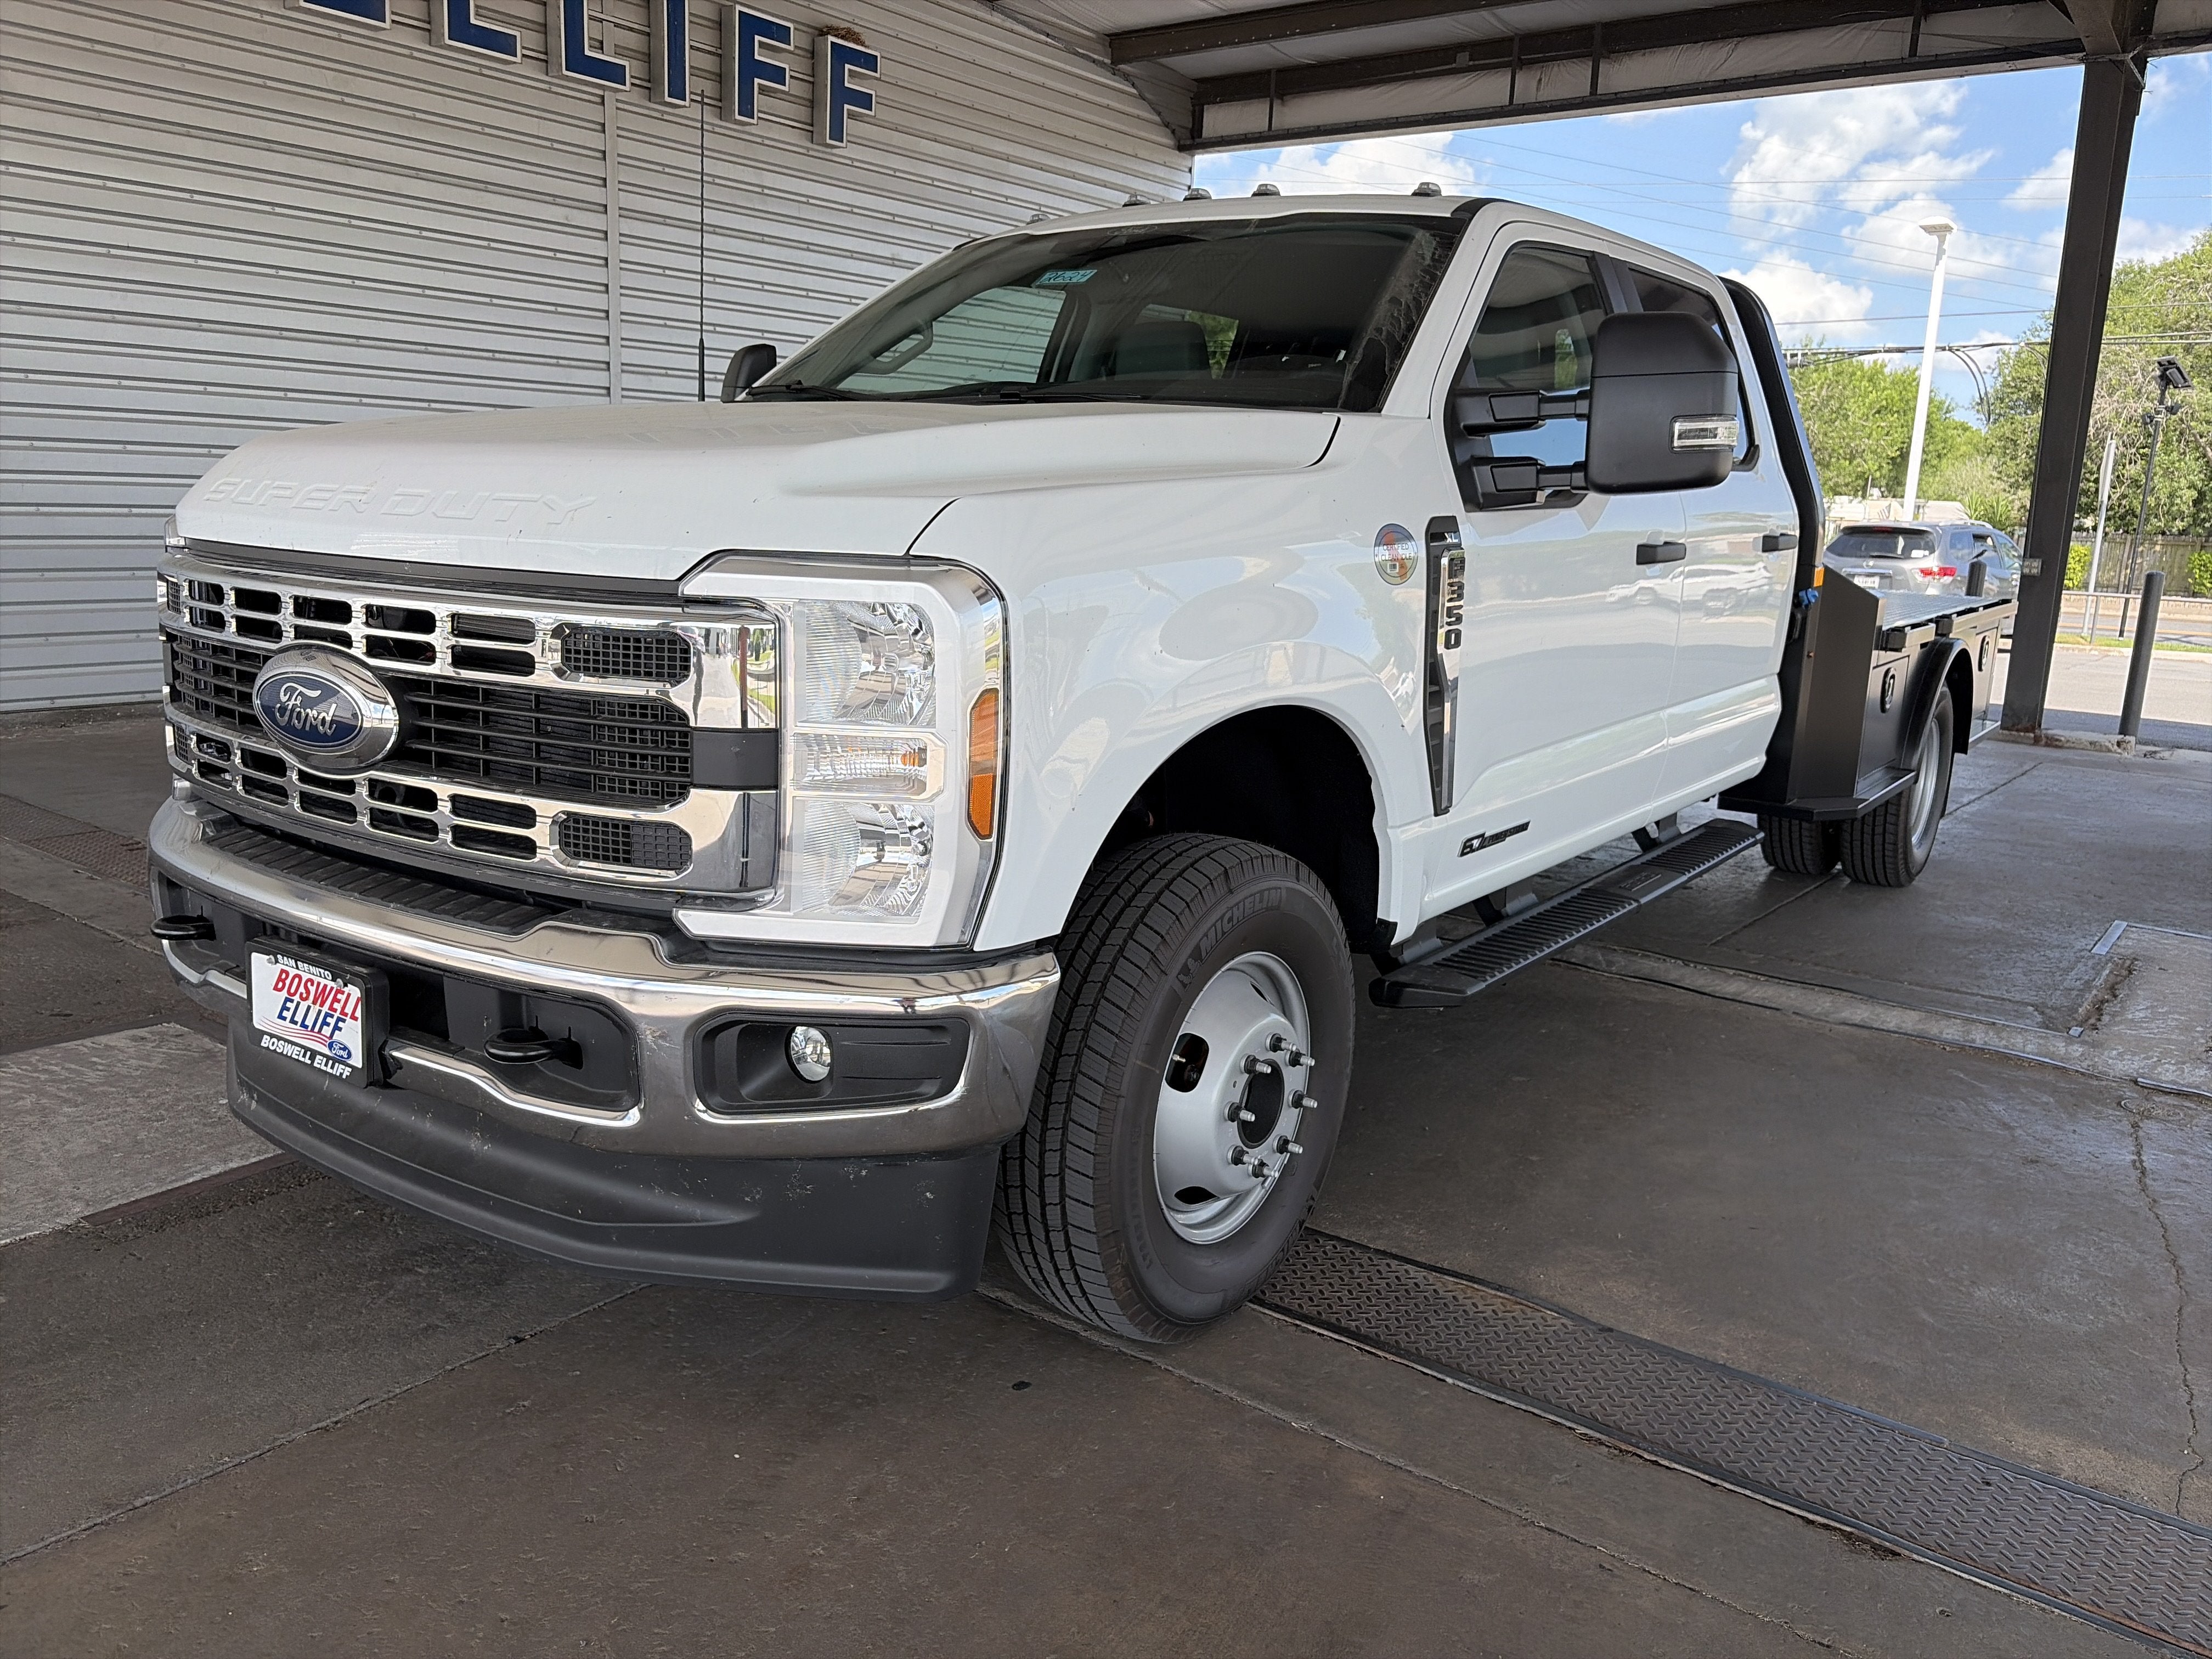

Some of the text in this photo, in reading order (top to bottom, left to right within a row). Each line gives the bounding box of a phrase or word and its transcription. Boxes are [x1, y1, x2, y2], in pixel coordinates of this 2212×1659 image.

[285, 0, 882, 149] LLIFF
[203, 477, 597, 525] SUPER DUTY
[1380, 552, 1413, 562] CLEAN IDLE
[1382, 543, 1409, 551] CERTIFIED
[1444, 532, 1459, 543] XL
[274, 682, 337, 736] Ford
[1199, 888, 1282, 960] MICHELIN
[276, 955, 332, 980] SAN BENITO
[272, 968, 362, 1022] BOSWELL
[276, 996, 347, 1040] ELLIFF
[260, 1034, 352, 1079] BOSWELL ELLIFF
[331, 1041, 348, 1059] Ford
